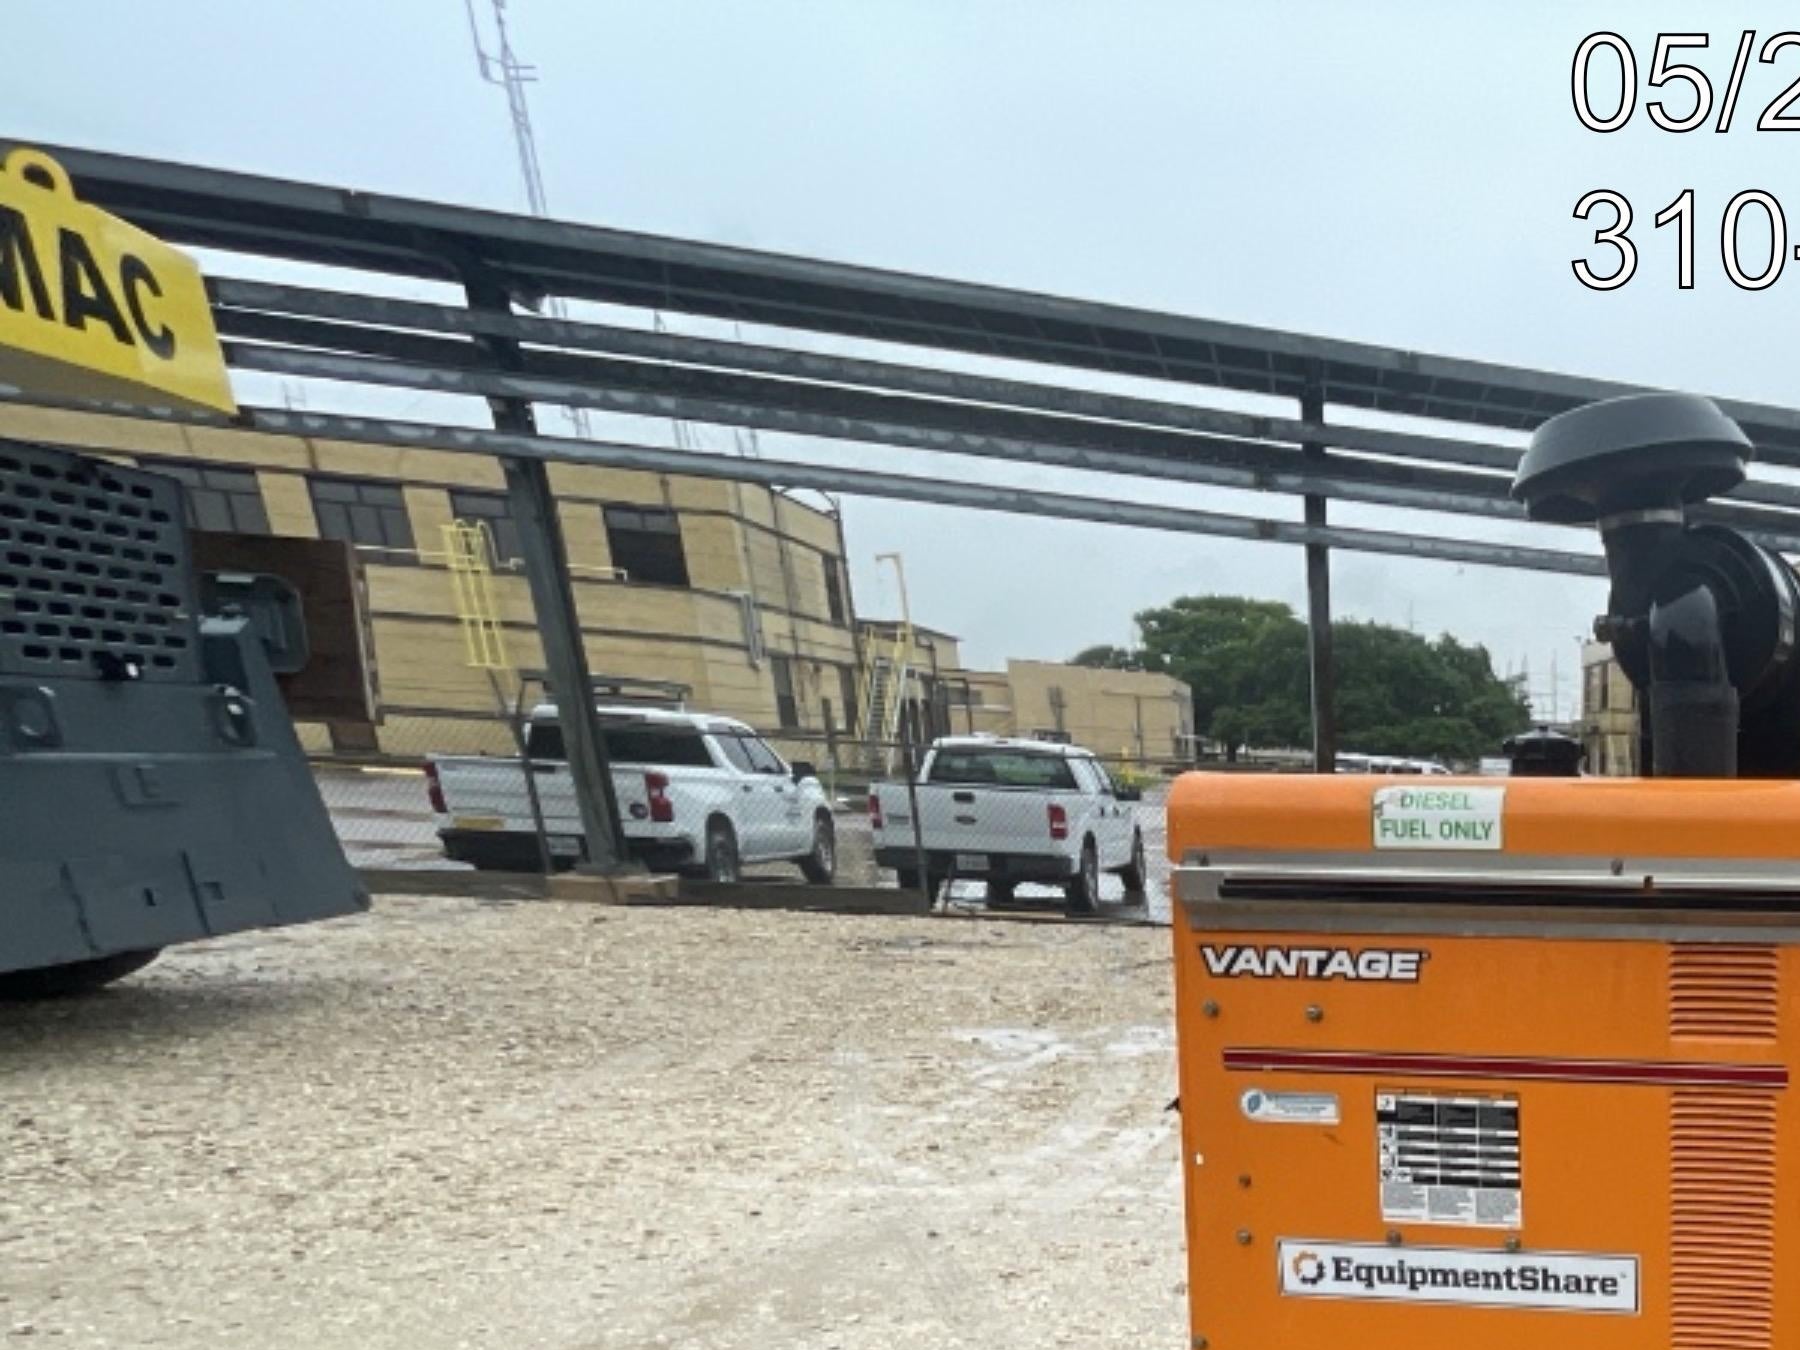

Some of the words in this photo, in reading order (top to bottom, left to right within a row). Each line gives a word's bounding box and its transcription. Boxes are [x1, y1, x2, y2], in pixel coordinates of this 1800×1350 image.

[1400, 791, 1473, 811] DIESEL
[1379, 818, 1431, 838] FUEL
[1439, 819, 1495, 840] ONLY
[1201, 946, 1420, 980] VANTAGE
[1332, 1256, 1619, 1296] EquipmentShare
